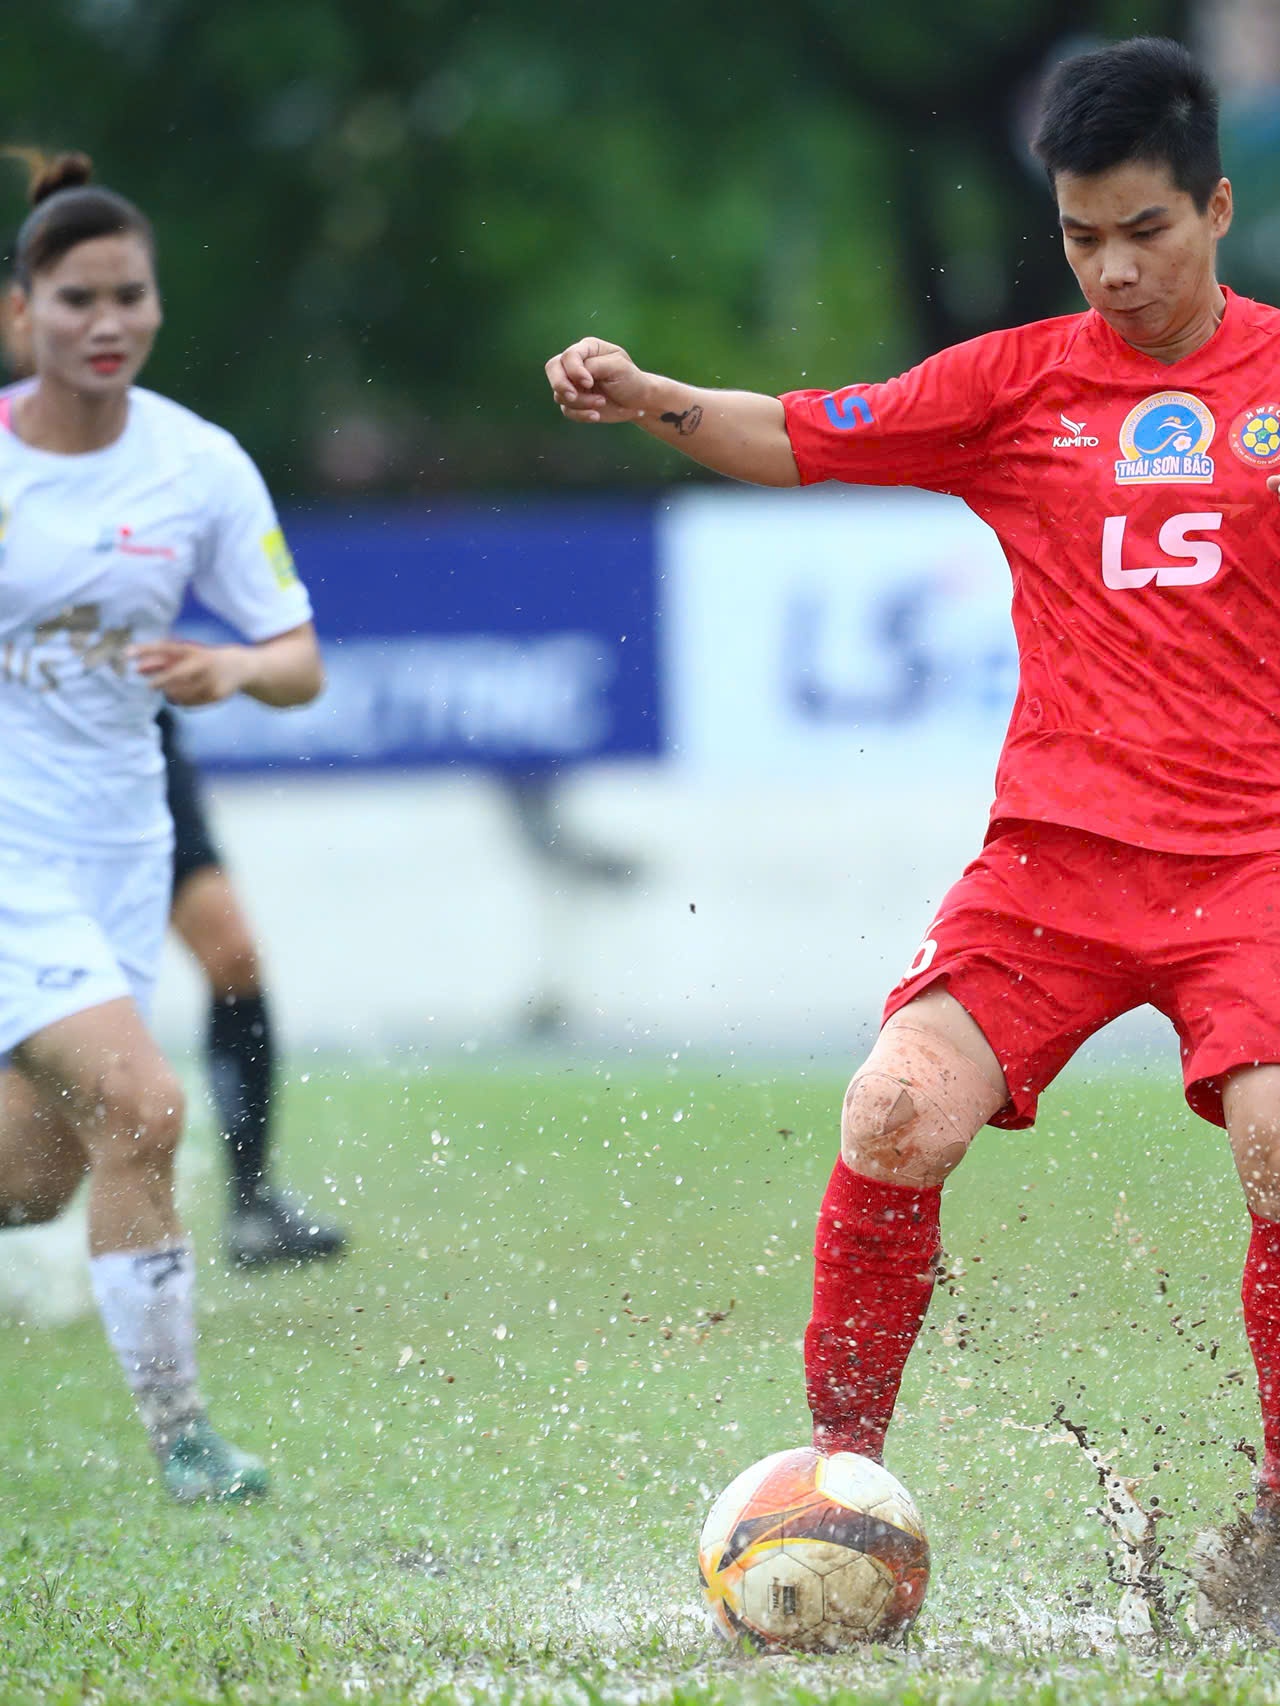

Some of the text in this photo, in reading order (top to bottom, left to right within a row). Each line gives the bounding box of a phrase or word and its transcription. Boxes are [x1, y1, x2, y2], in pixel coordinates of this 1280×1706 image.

[1052, 436, 1099, 448] KAMITO
[1119, 454, 1210, 476] THÁI SƠN BẮC
[1102, 512, 1223, 590] LS
